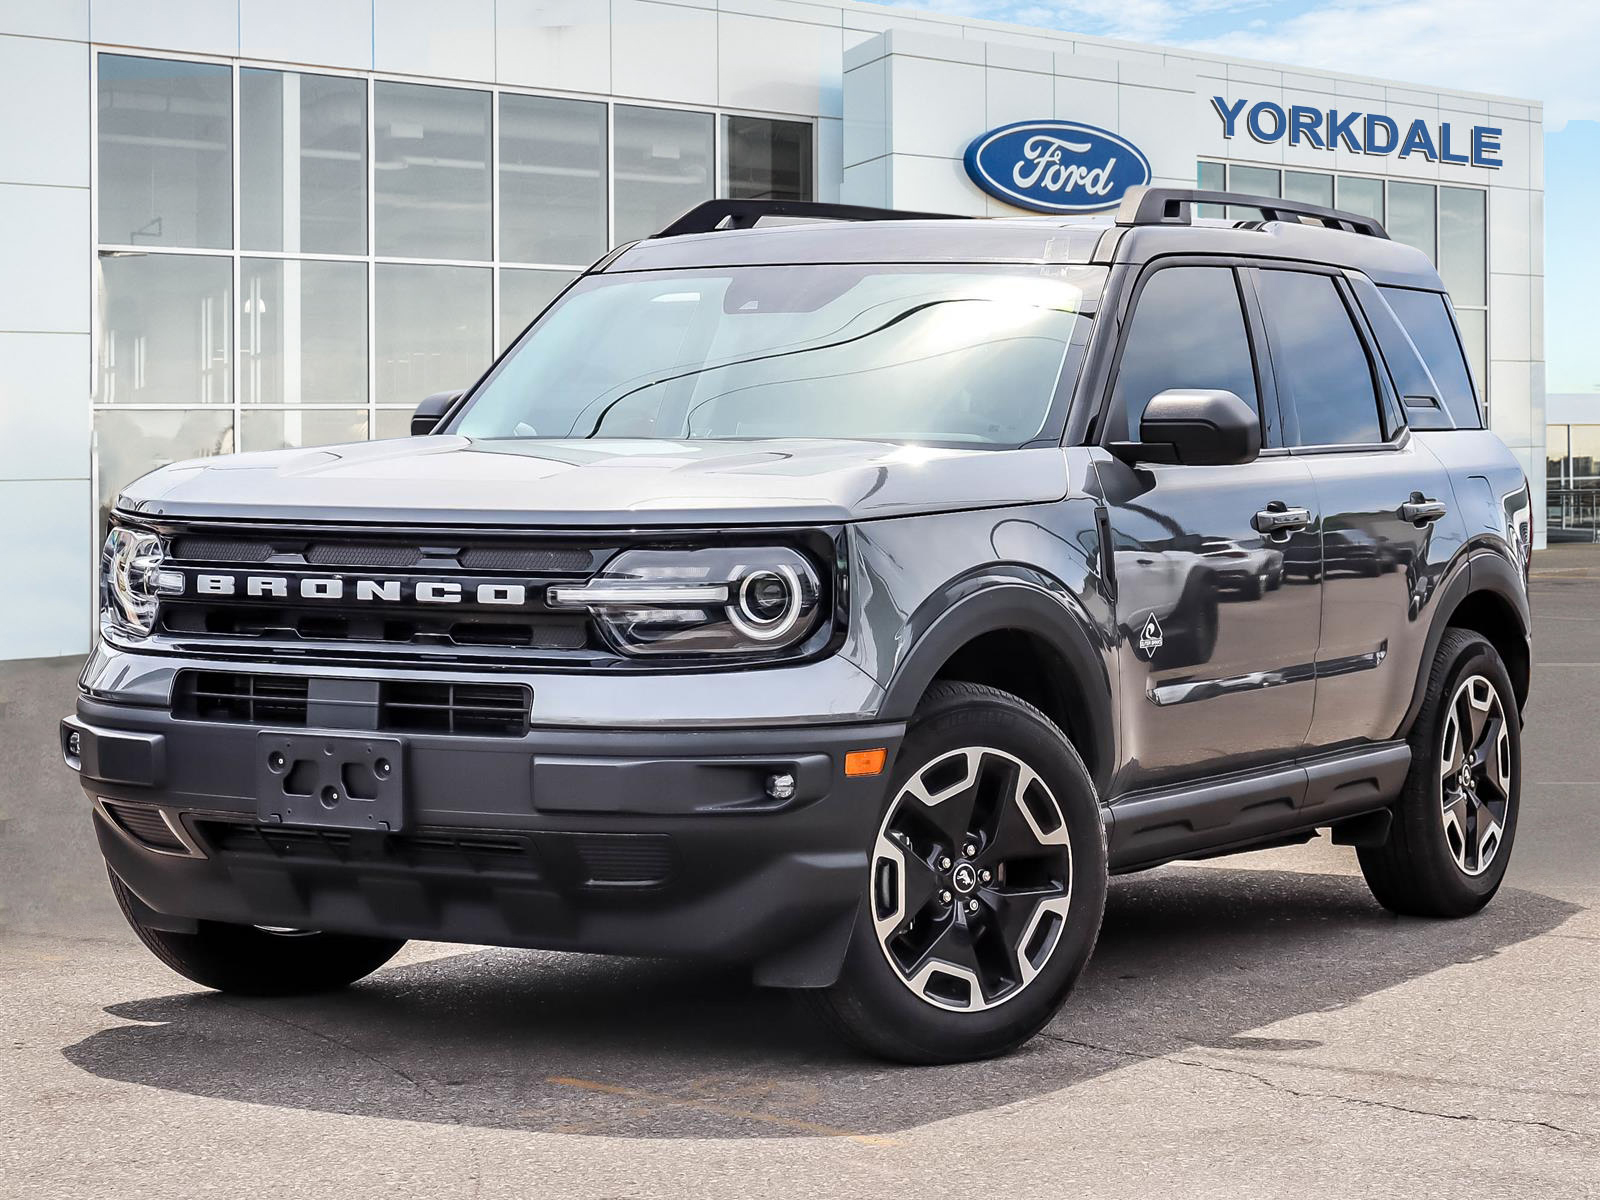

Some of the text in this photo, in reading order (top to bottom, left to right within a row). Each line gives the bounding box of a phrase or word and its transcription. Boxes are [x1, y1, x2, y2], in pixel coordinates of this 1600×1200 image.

[1212, 96, 1503, 168] YORKDALE
[1012, 134, 1117, 196] Ford
[197, 574, 525, 605] BRONCO
